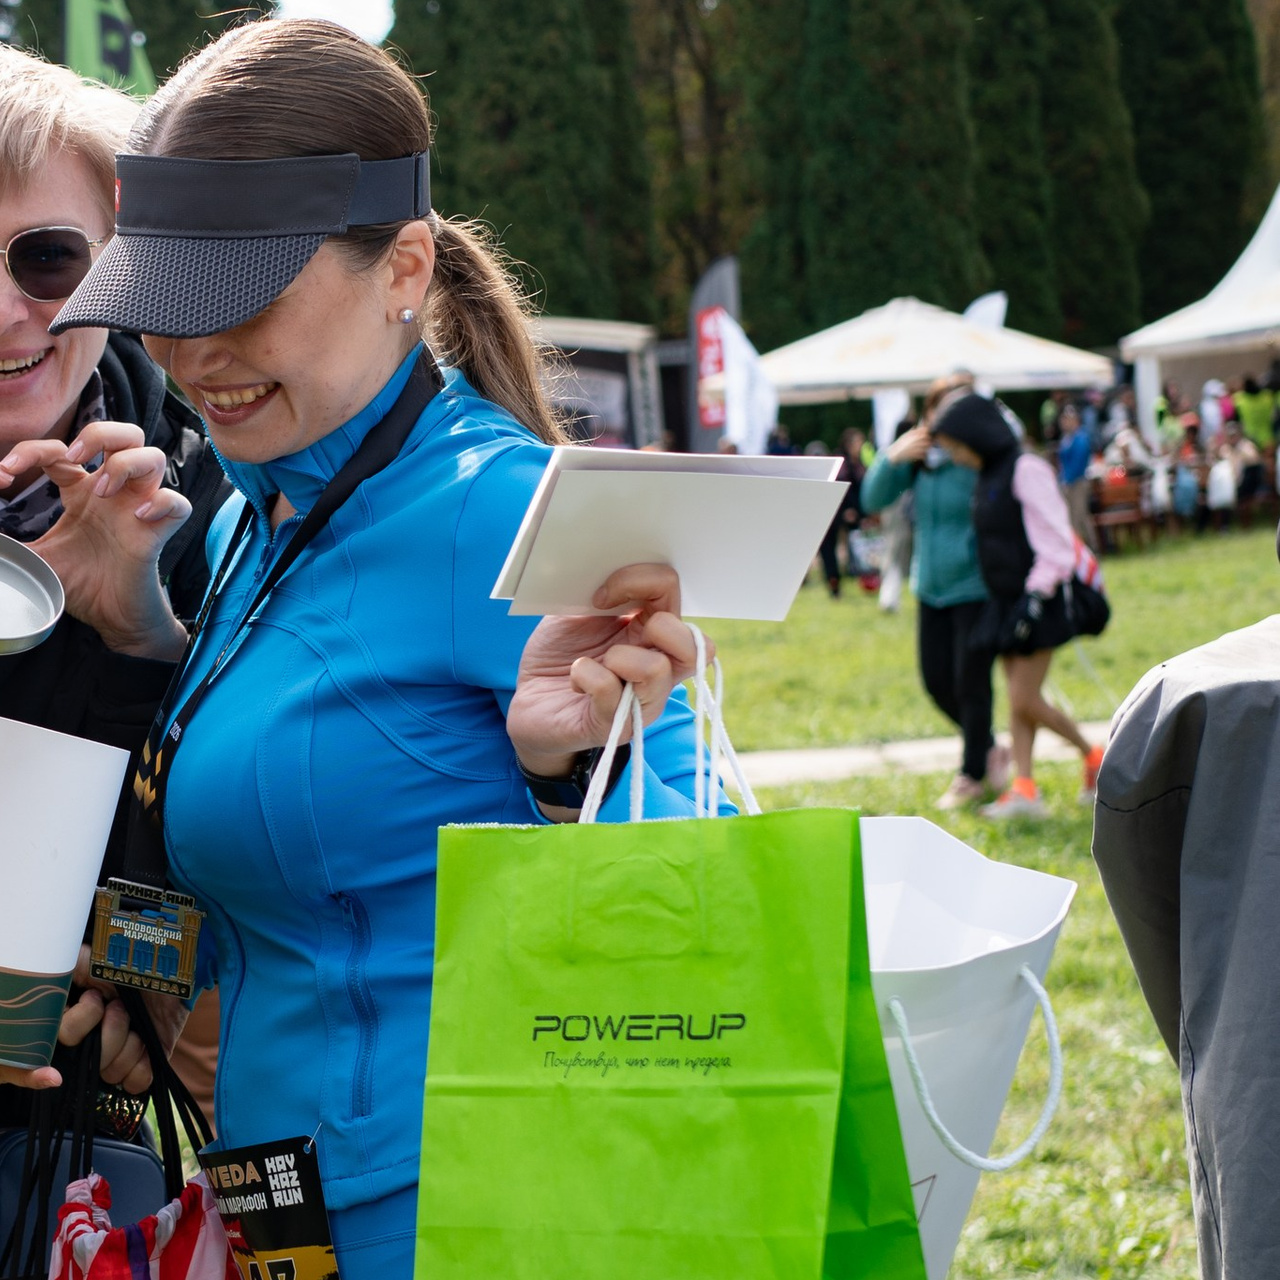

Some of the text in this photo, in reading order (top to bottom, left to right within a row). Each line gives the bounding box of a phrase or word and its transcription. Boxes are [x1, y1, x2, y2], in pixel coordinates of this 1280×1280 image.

[110, 918, 182, 940] КИСЛОВОДСКИЙ
[123, 929, 167, 946] МАРАФОН
[102, 967, 180, 994] MAYRVEDA
[532, 1013, 746, 1042] POWERUP
[625, 1057, 650, 1068] что
[654, 1056, 680, 1068] нет
[264, 1153, 295, 1174] KAV
[207, 1161, 262, 1189] VEDA
[268, 1170, 300, 1191] KAZ
[225, 1192, 268, 1214] МАРАФОН
[272, 1187, 304, 1208] RUN
